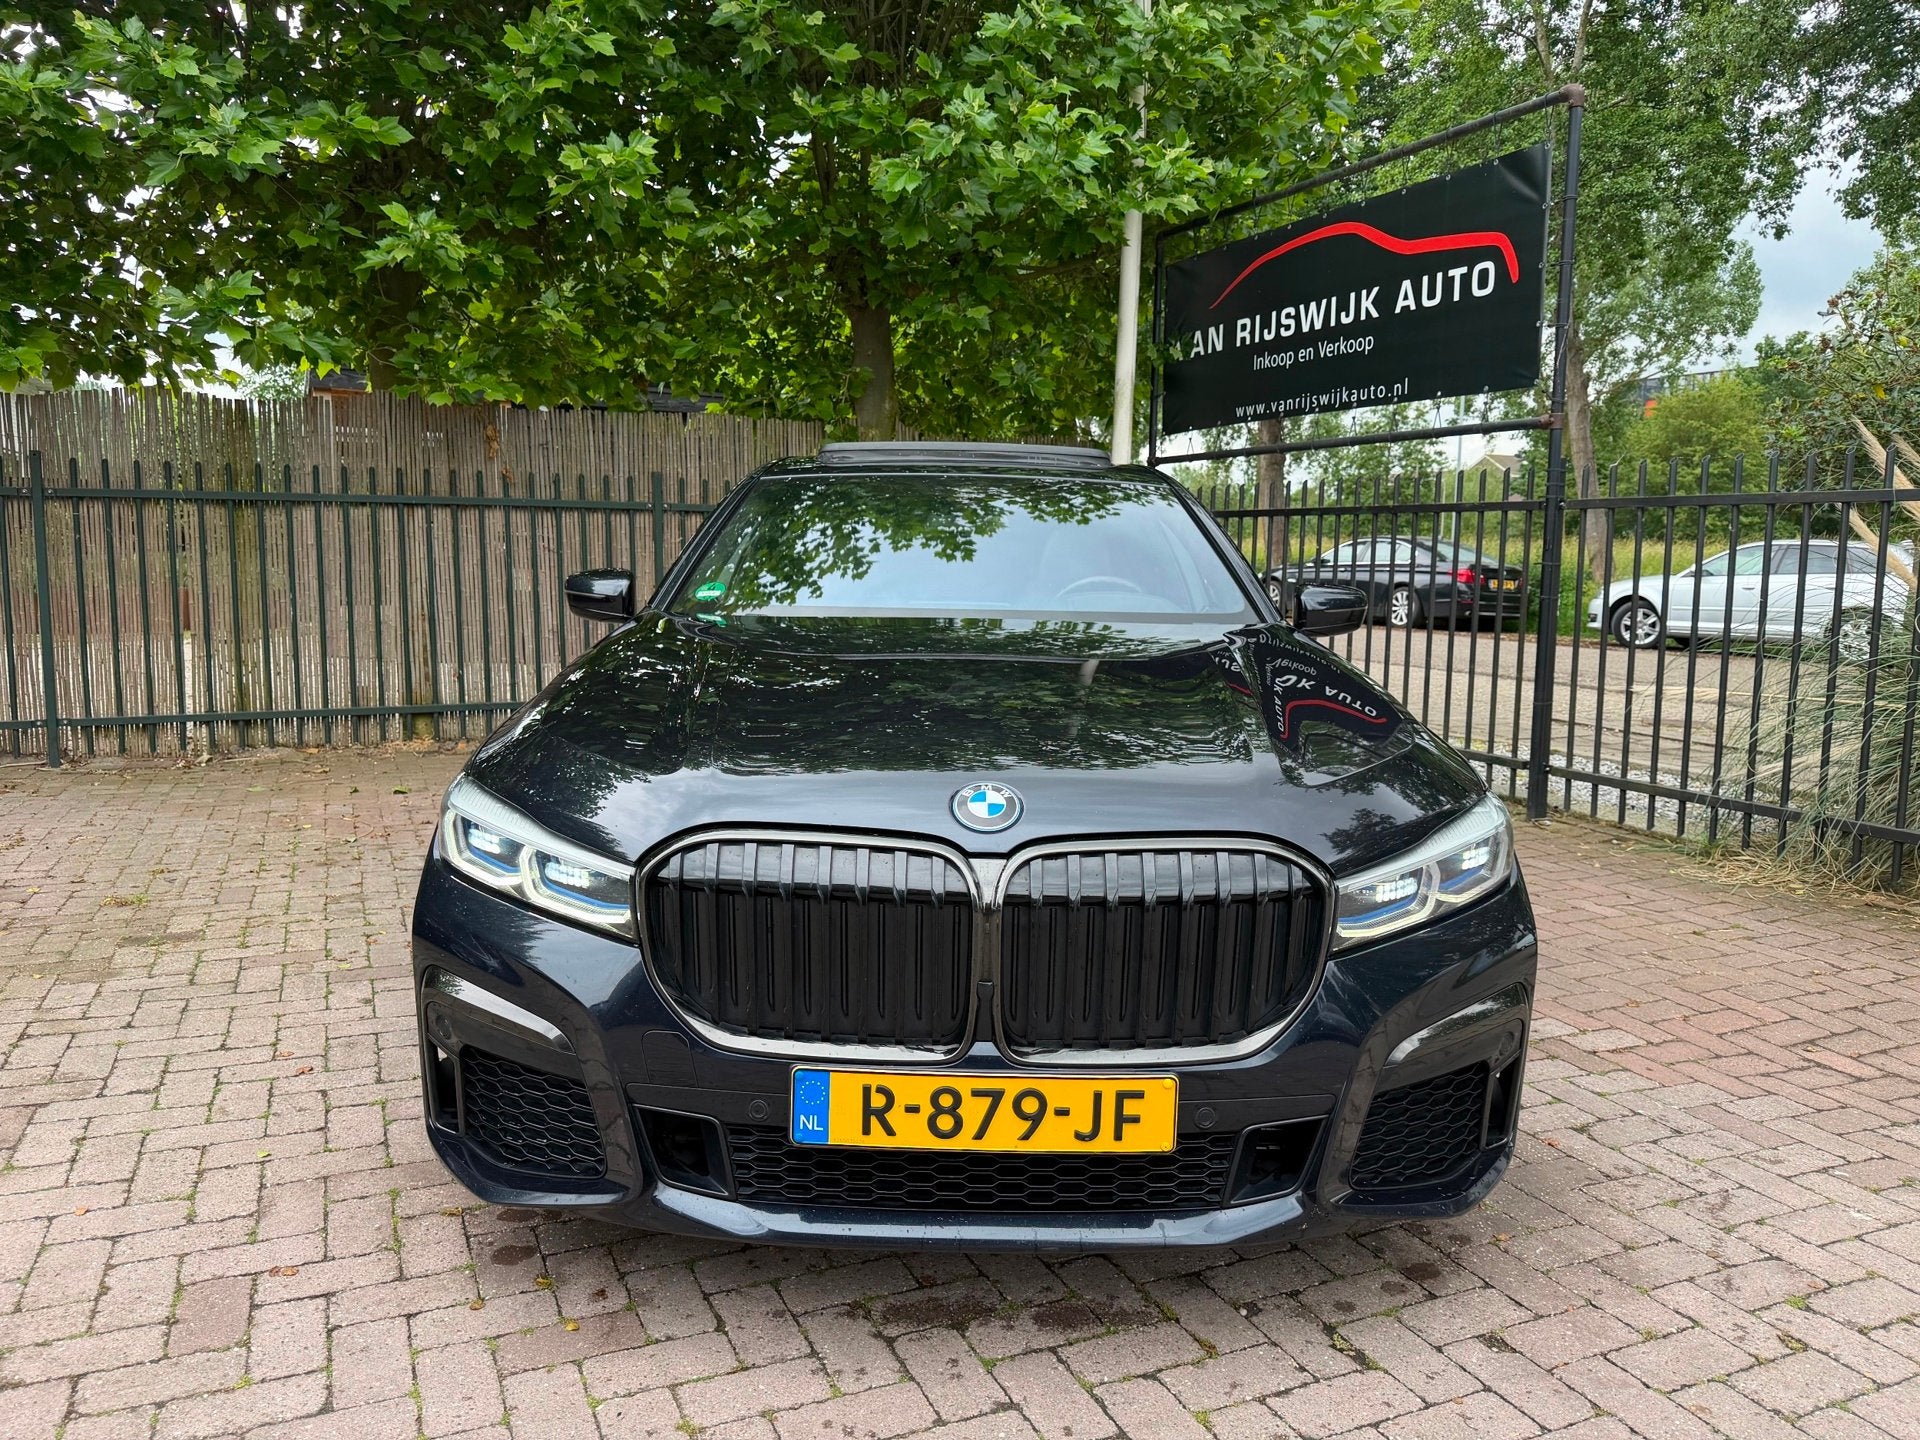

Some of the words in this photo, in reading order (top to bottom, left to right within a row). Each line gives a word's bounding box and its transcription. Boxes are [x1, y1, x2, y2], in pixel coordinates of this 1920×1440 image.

[1174, 323, 1224, 361] AN
[1235, 286, 1380, 348] RIJSWIJK
[1394, 260, 1496, 314] AUTO
[1252, 348, 1294, 371] Inkoop
[1298, 346, 1314, 363] en
[1318, 334, 1375, 361] Verkoop
[1235, 378, 1409, 418] www.vanrijswijkauto.nl
[962, 785, 1012, 798] BMW
[800, 1114, 823, 1131] NL
[861, 1083, 1146, 1142] R-879-JF
